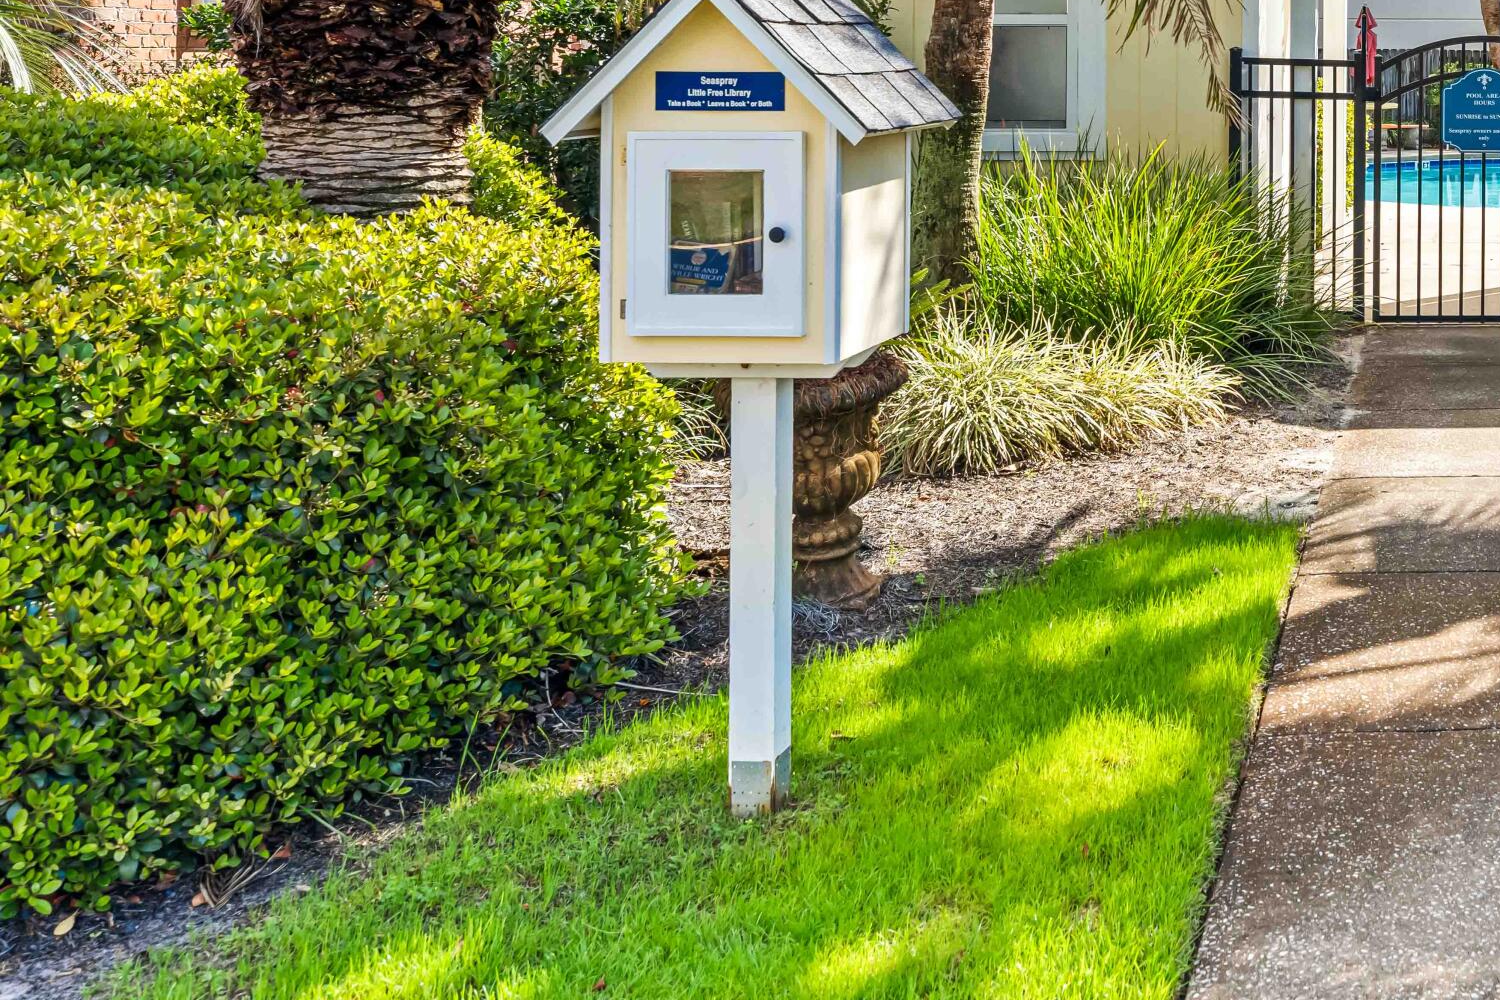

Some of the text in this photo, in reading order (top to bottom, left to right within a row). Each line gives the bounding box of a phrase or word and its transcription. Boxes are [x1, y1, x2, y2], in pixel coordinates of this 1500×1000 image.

[700, 76, 738, 86] Seaspray
[687, 88, 751, 98] Little Free Library
